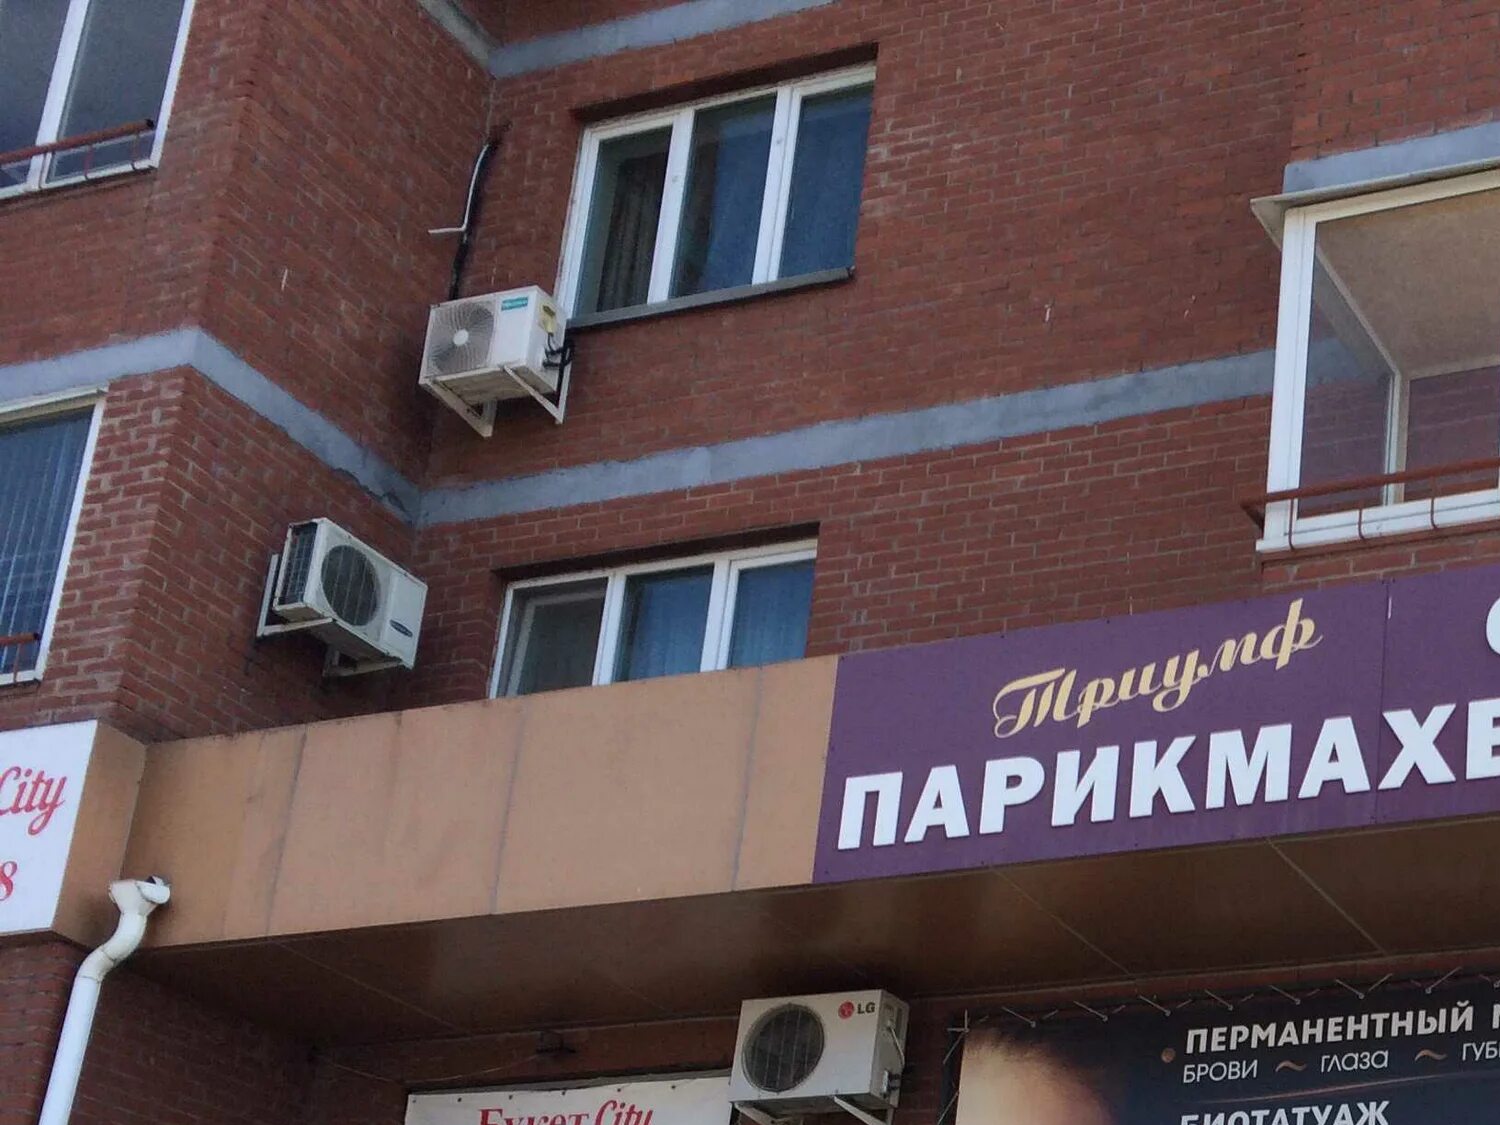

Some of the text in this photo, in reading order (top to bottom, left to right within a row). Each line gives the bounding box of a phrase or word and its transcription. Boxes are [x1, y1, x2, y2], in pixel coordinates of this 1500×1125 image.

[993, 597, 1324, 739] Триумф
[857, 1001, 876, 1015] LG
[1185, 1000, 1475, 1055] ПЕРМАНЕНТНЫЙ
[1182, 1059, 1259, 1084] БРОВИ
